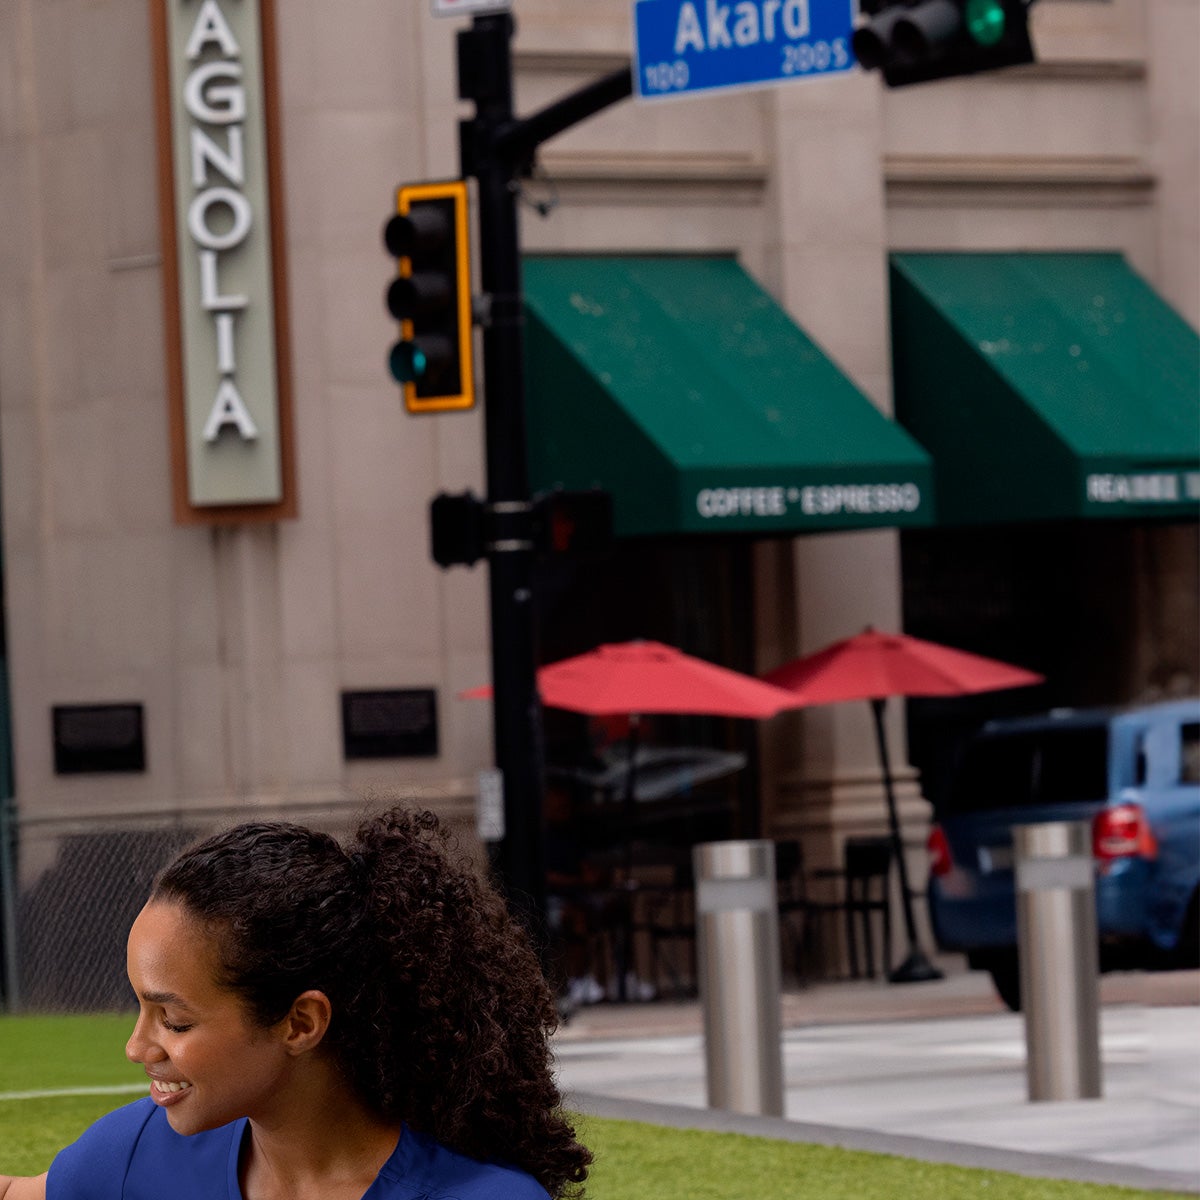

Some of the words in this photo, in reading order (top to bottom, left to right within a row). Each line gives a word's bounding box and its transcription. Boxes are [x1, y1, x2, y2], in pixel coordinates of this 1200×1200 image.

[675, 0, 811, 55] Akard
[696, 487, 788, 518] COFFEE
[801, 482, 921, 515] ESPRESSO
